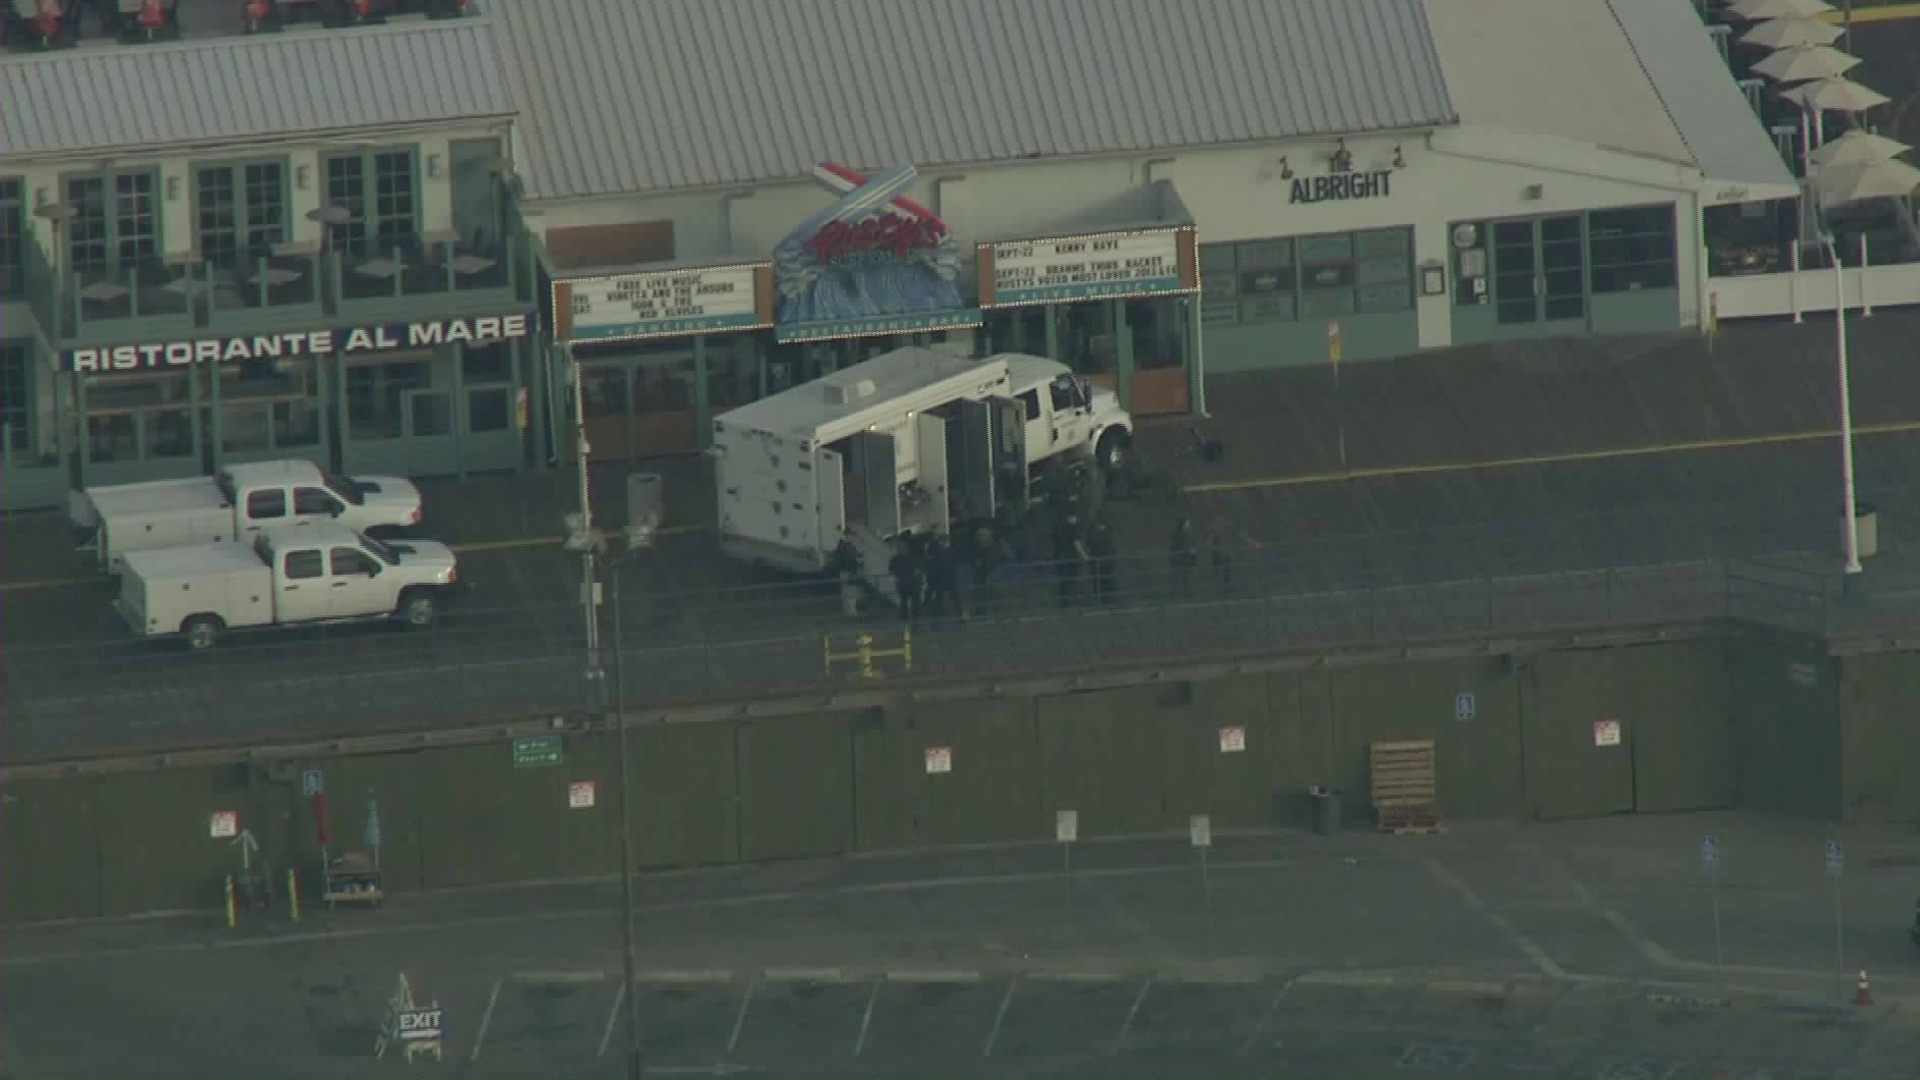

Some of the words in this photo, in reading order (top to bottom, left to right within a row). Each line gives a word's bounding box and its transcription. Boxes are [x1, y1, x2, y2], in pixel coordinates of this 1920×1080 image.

[1289, 169, 1393, 204] ALBRIGHT
[647, 278, 667, 288] LIVE
[672, 275, 701, 286] MUSIC
[1071, 272, 1098, 282] MOST
[653, 287, 671, 298] AND
[675, 285, 692, 297] THE
[1086, 281, 1142, 294] MUSIC
[675, 295, 692, 306] THE
[73, 330, 333, 372] RISTORANTE
[346, 327, 397, 351] AL
[408, 314, 527, 346] MARE
[399, 1011, 441, 1029] EXIT
